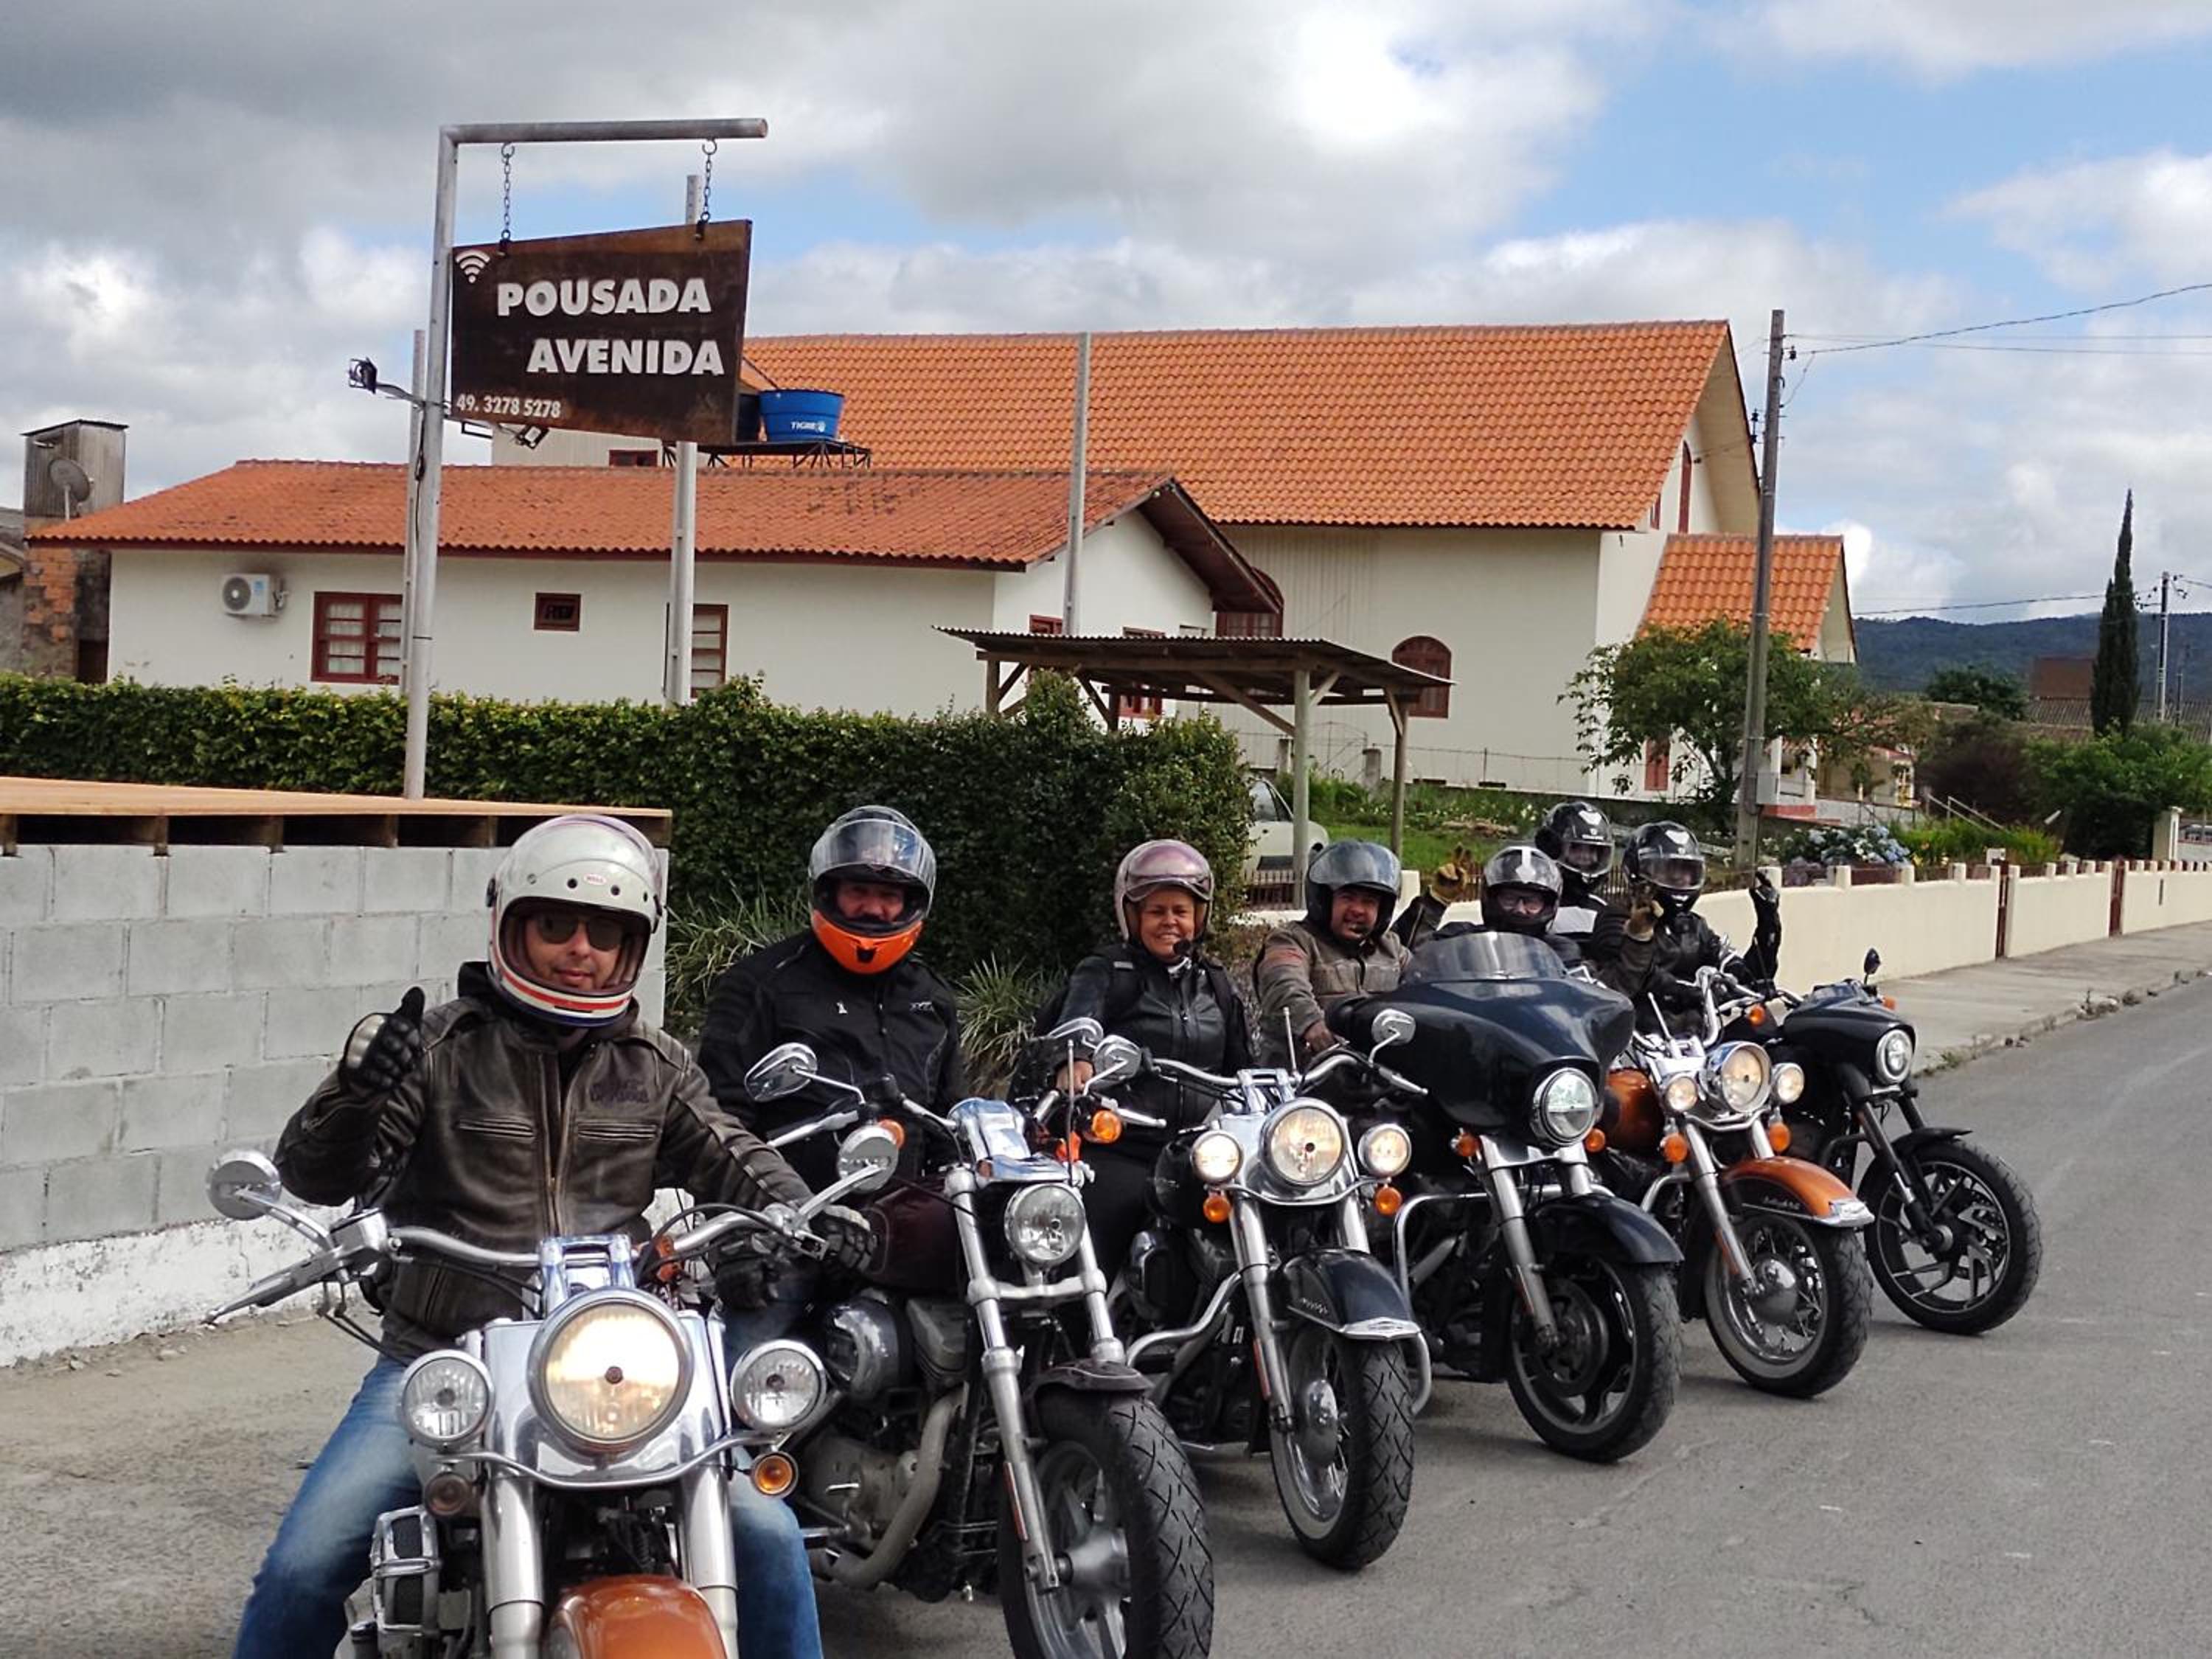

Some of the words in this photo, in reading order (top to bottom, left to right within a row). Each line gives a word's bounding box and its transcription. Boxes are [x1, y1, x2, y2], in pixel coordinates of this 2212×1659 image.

[497, 277, 712, 317] POUSADA
[526, 338, 726, 376] AVENIDA
[456, 393, 479, 411] 49.
[483, 394, 520, 415] 3278
[523, 399, 561, 418] 5278
